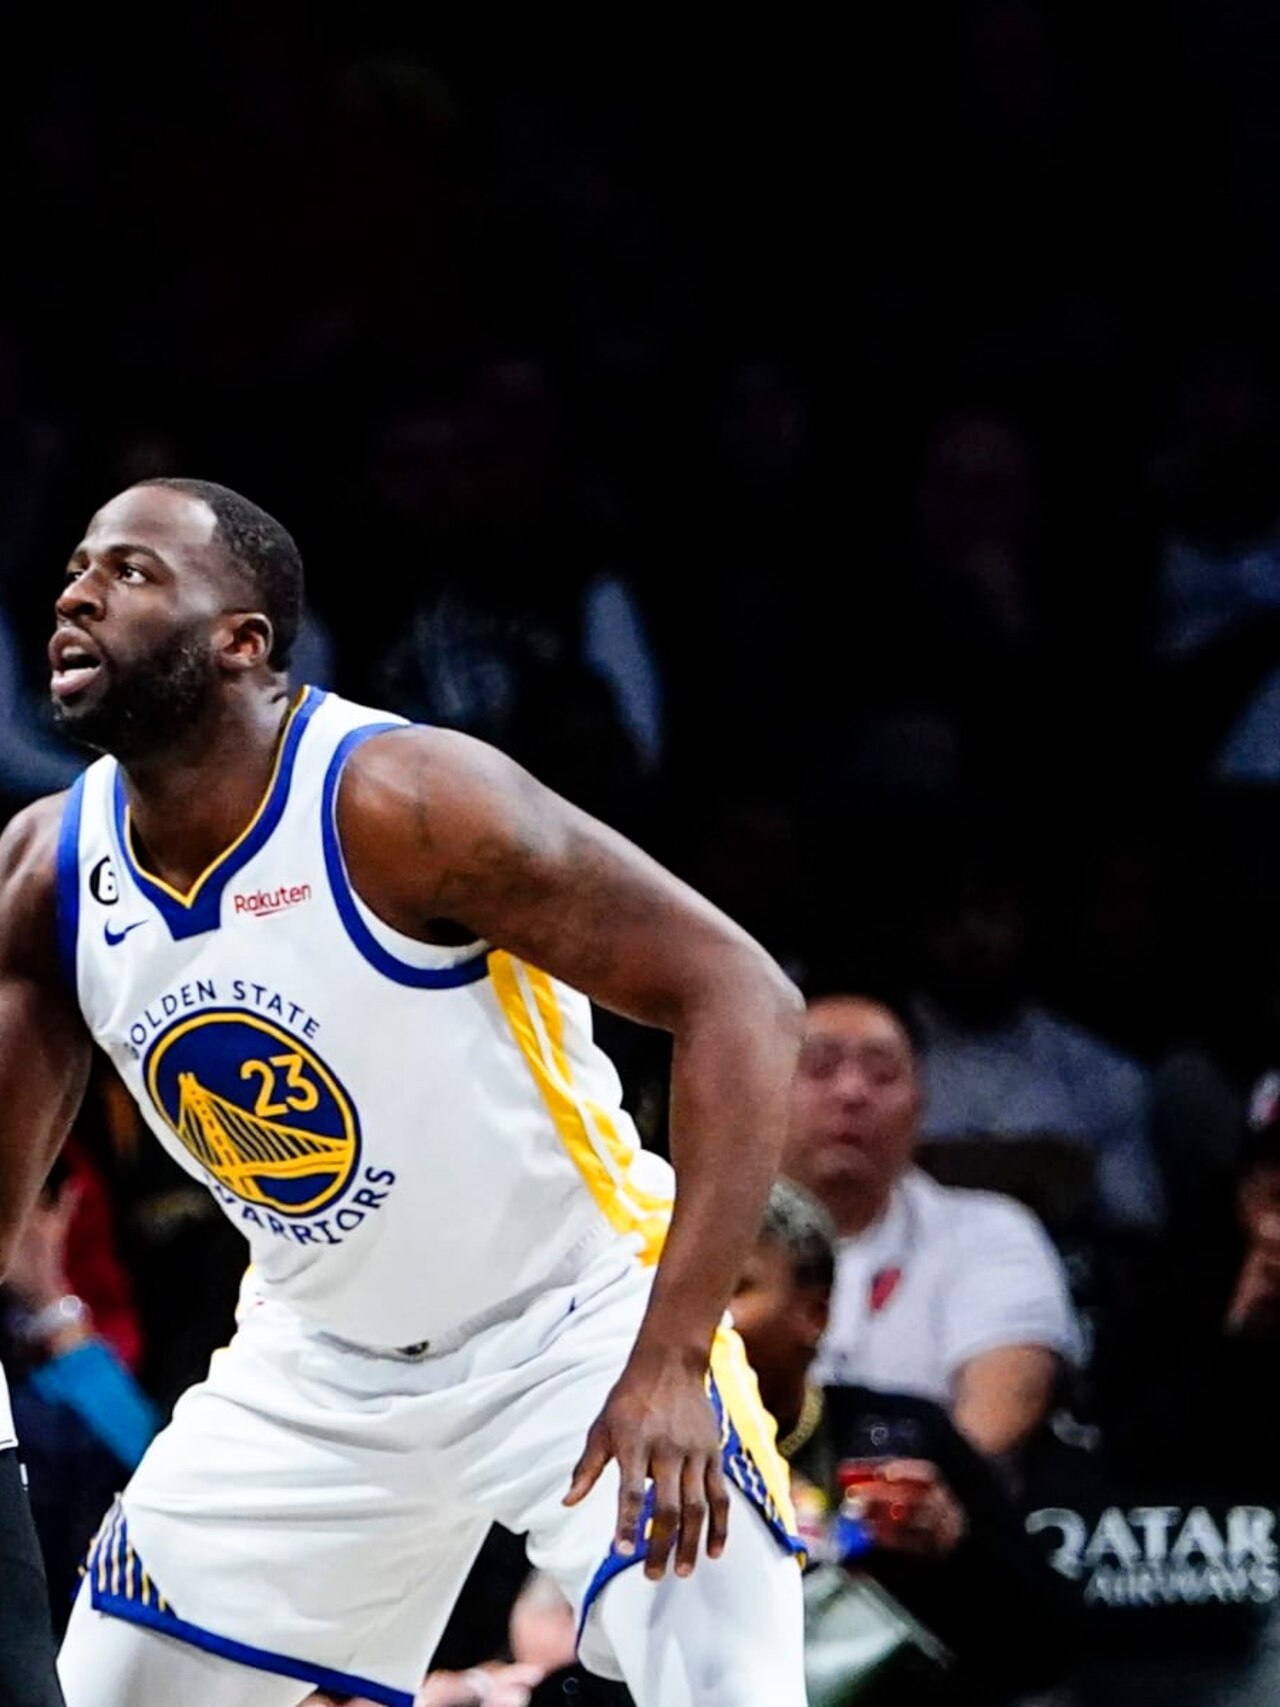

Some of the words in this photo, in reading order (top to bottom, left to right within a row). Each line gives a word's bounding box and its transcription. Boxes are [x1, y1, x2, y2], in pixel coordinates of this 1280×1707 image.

[233, 884, 312, 917] Rakuten
[232, 980, 320, 1040] STATE
[240, 1053, 319, 1117] 23
